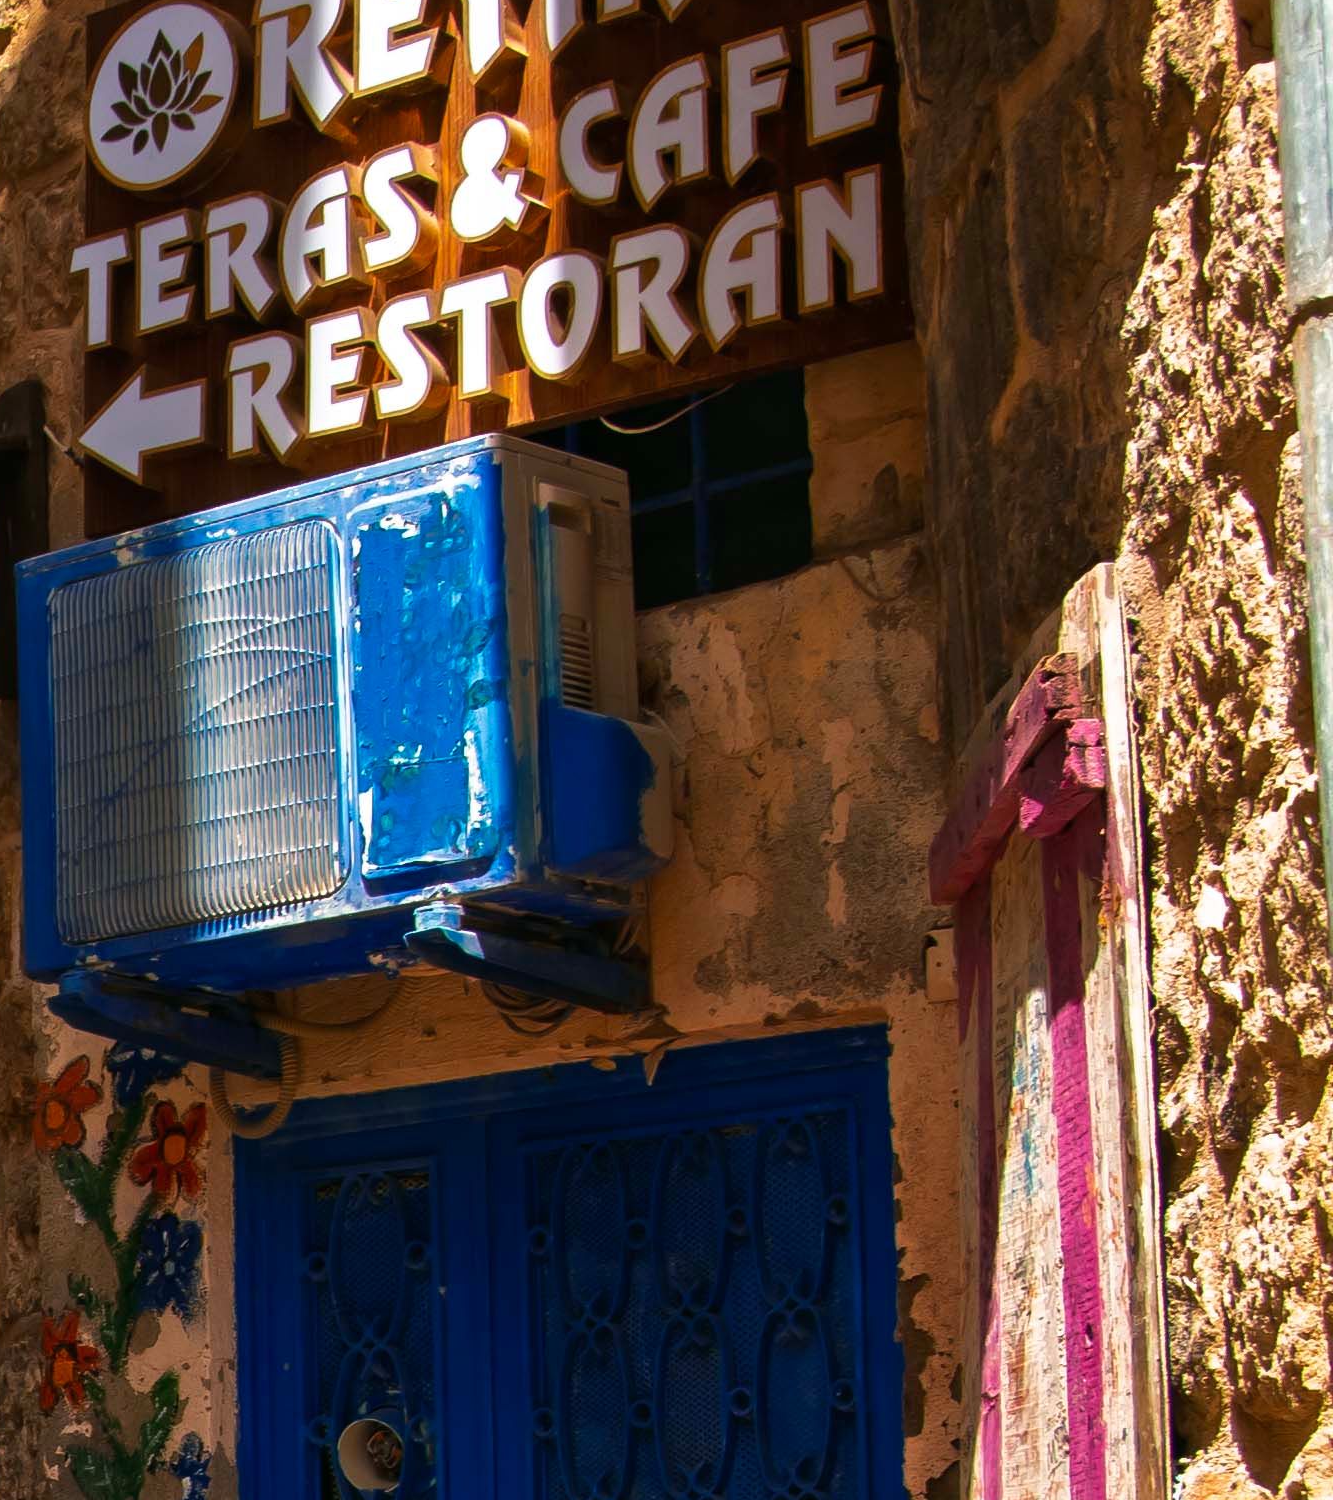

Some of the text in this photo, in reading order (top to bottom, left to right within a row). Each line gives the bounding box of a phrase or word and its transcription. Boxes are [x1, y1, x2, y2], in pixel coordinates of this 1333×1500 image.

[70, 1, 880, 350] TERAS & CAFE
[226, 164, 884, 460] RESTORAN
